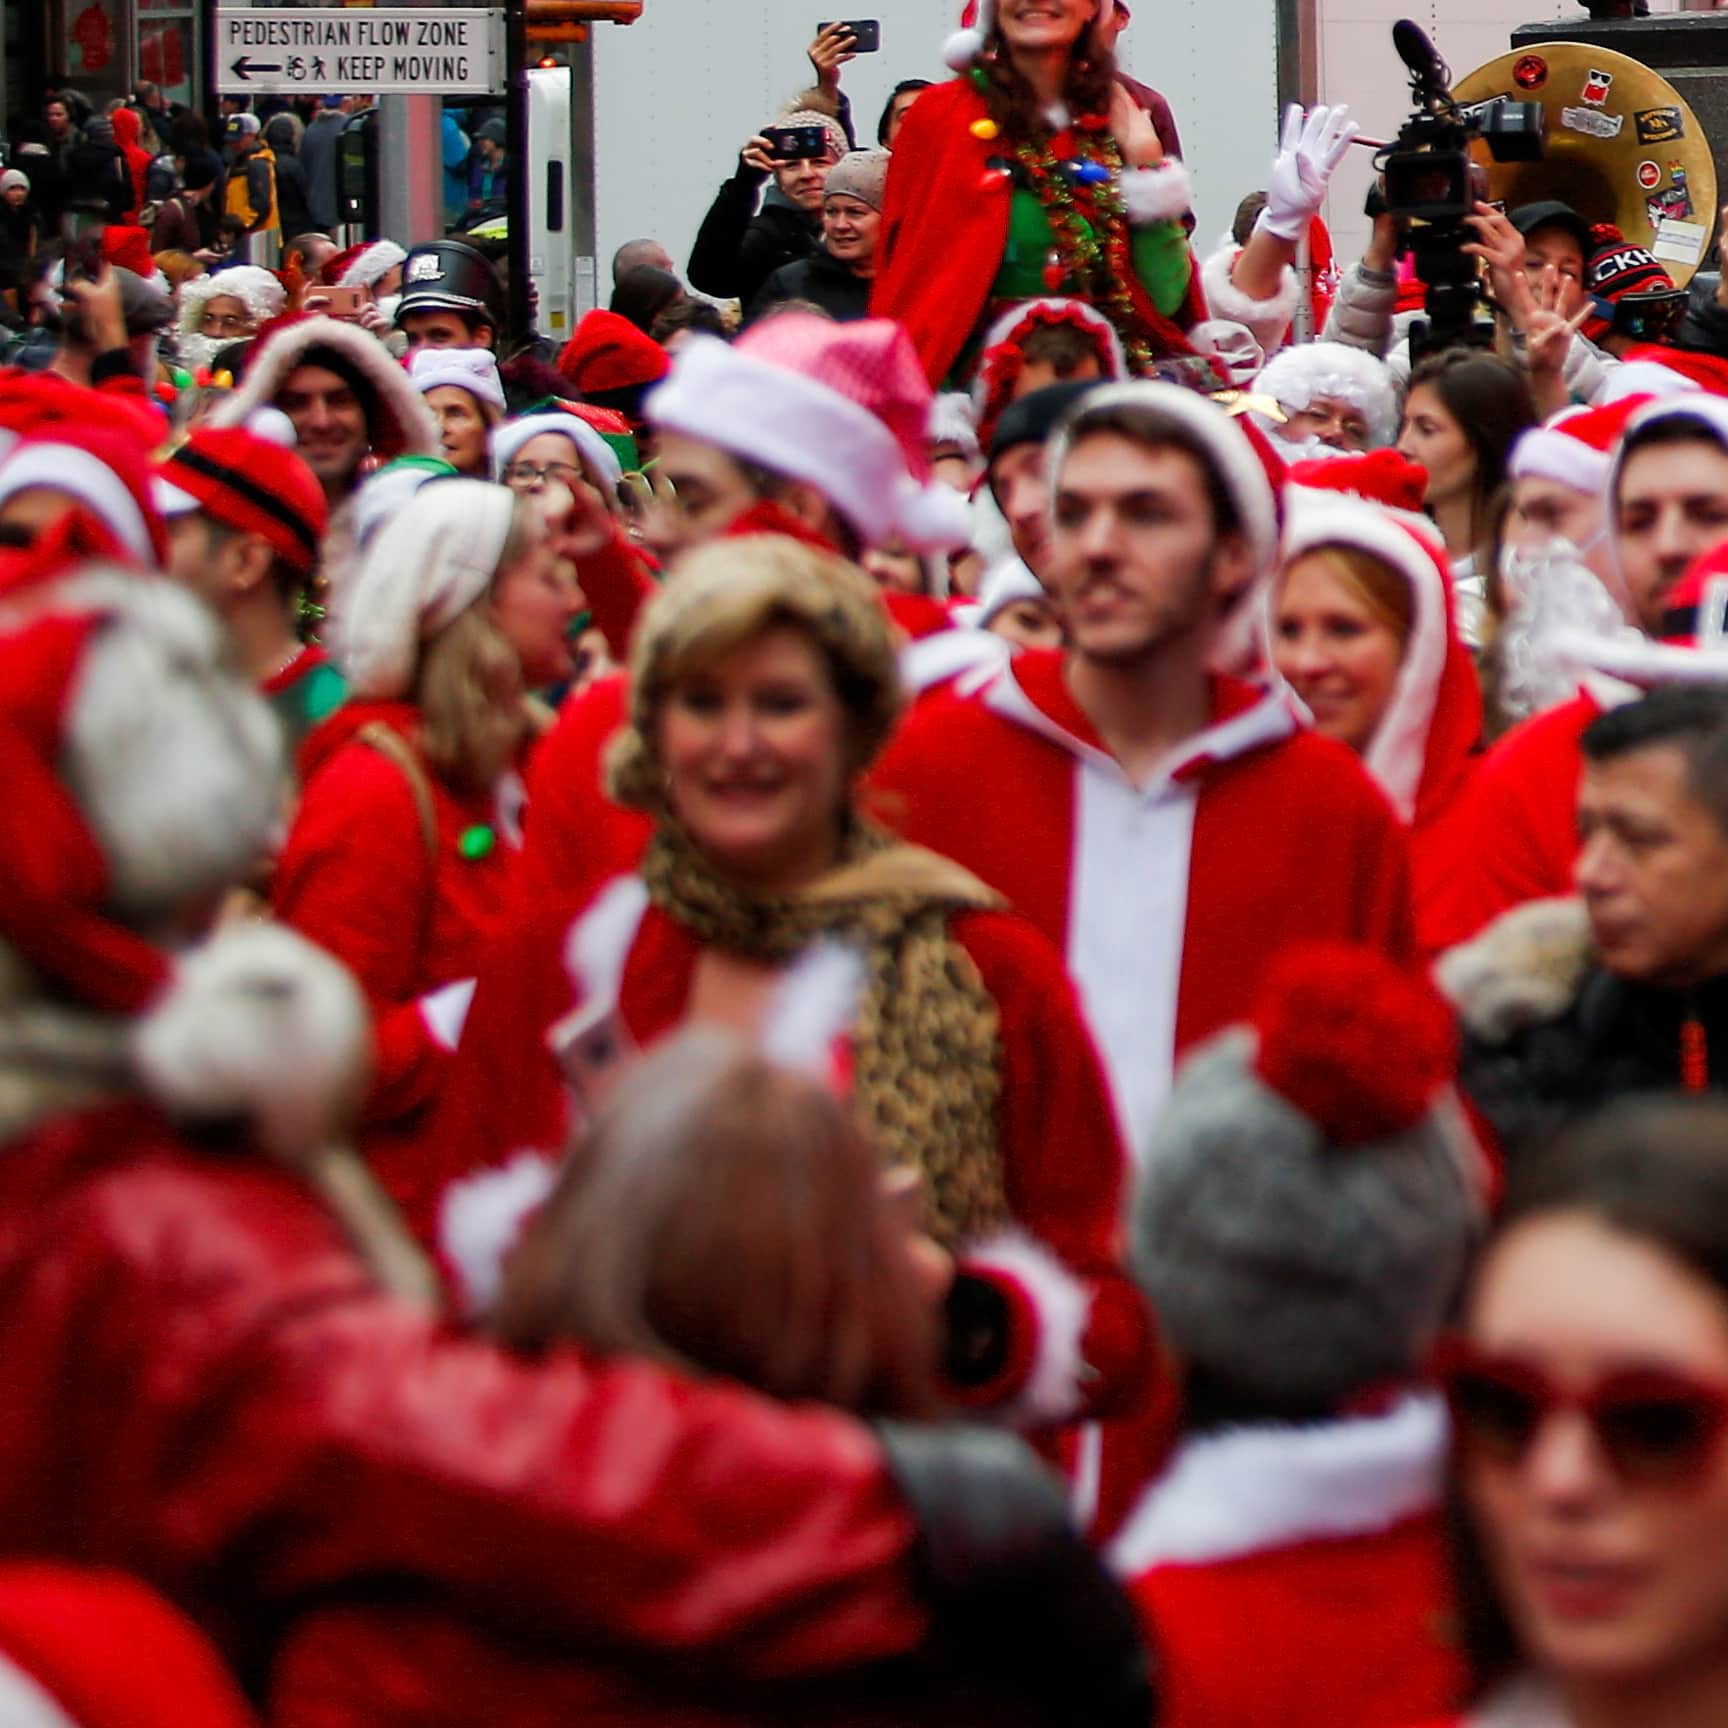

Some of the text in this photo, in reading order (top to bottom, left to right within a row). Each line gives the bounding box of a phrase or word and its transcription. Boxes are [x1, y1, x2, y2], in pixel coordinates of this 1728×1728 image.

[230, 21, 468, 46] PEDESTRIAN FLOW ZONE
[338, 56, 468, 81] KEEP MOVING
